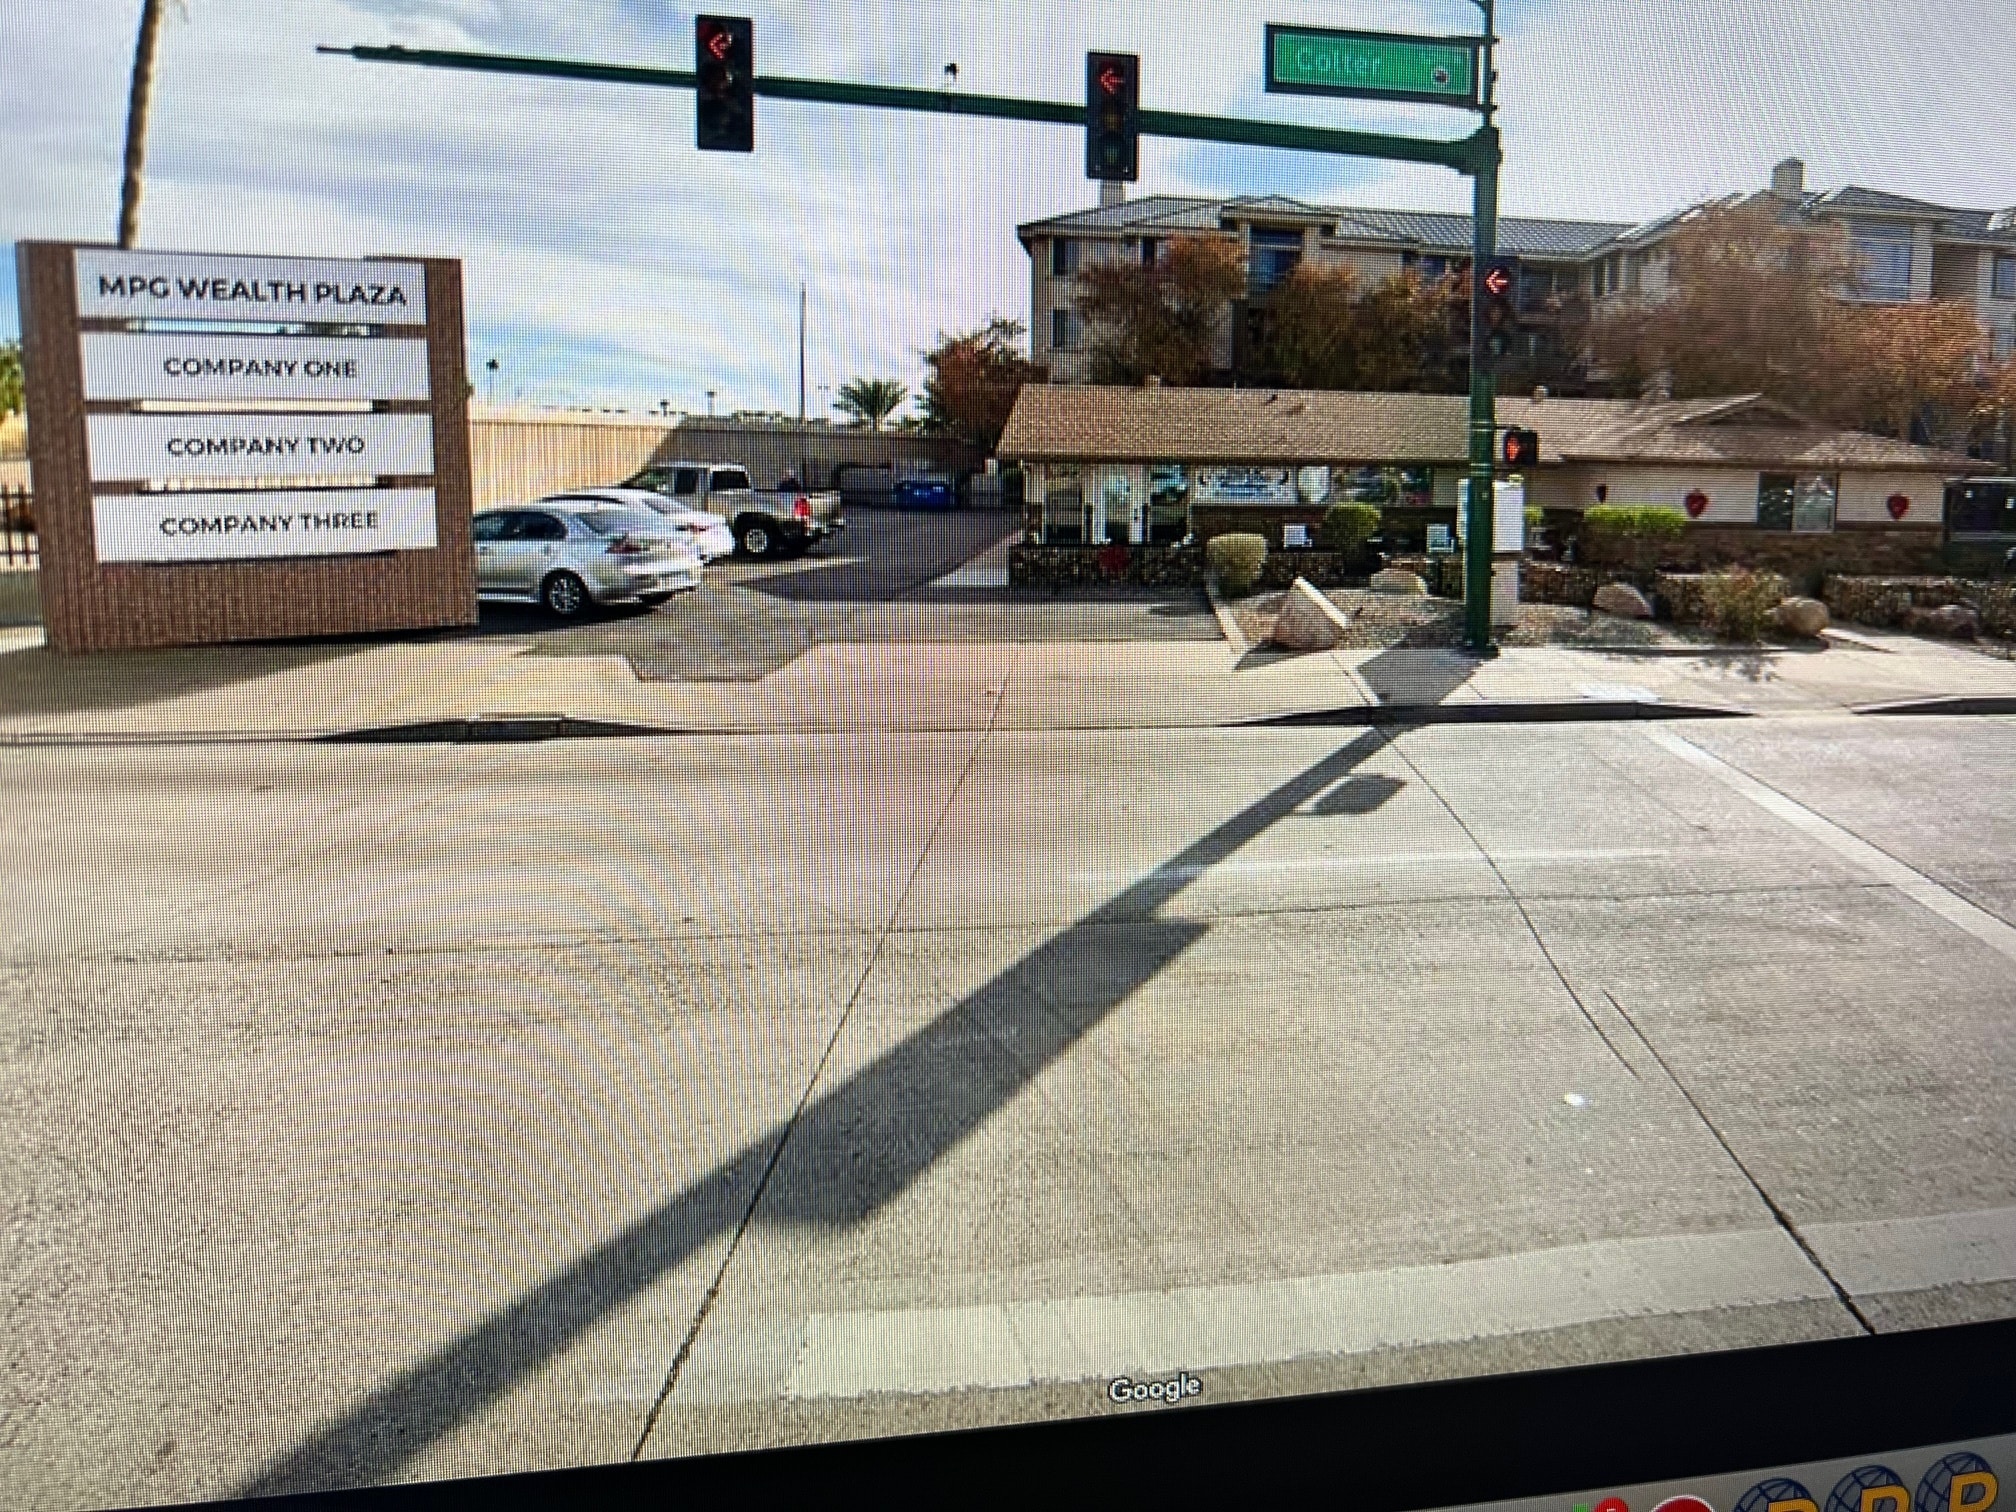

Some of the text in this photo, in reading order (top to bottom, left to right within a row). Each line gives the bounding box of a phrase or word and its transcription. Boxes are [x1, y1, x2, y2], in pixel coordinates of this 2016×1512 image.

[1296, 46, 1381, 74] Colter
[98, 275, 407, 306] MPG WEALTH PLAZA
[163, 356, 358, 378] COMPANY ONE
[166, 434, 366, 457] COMPANY TWO
[159, 511, 379, 537] COMPANY THREE
